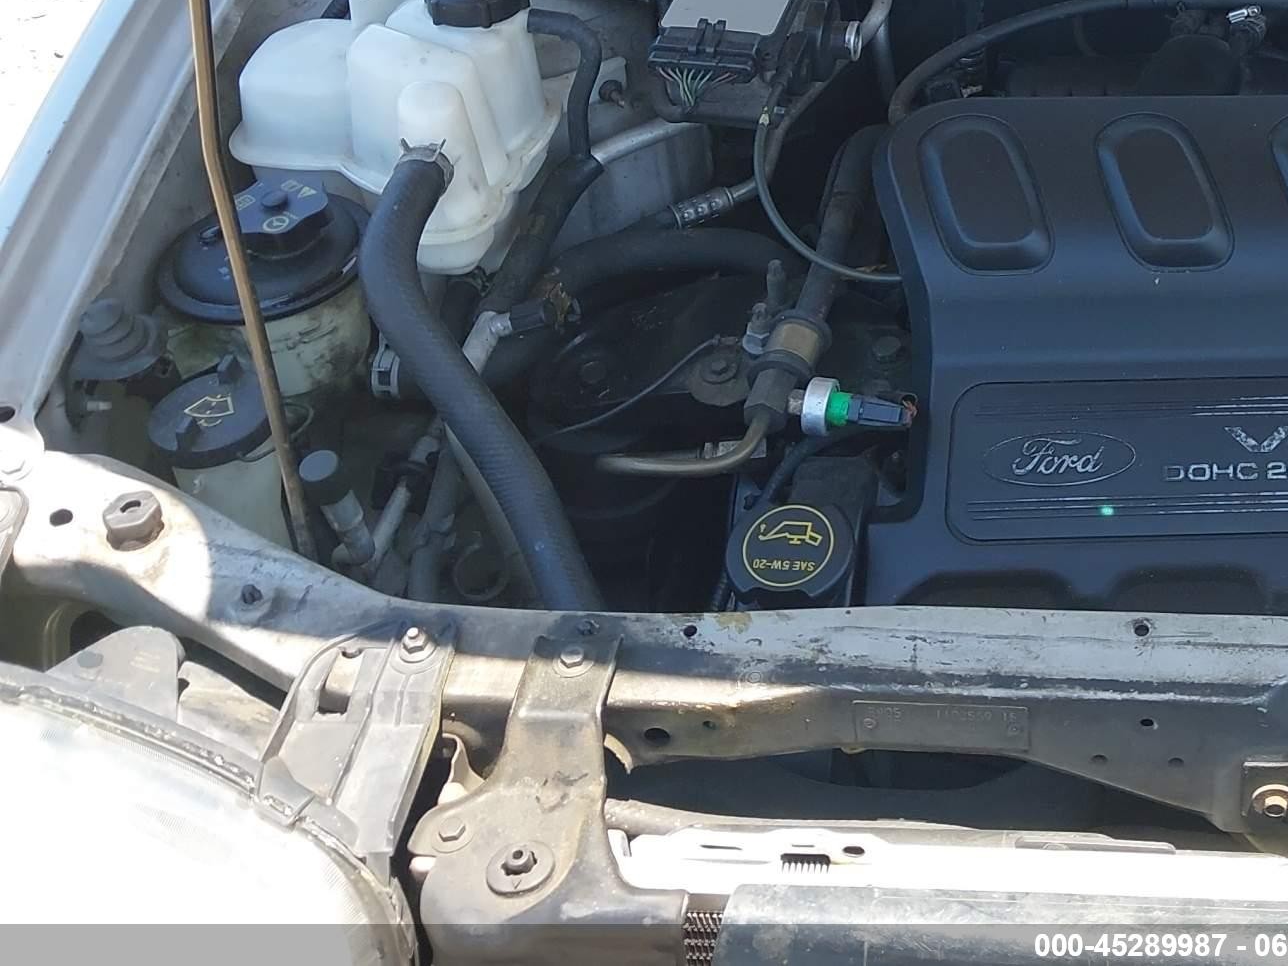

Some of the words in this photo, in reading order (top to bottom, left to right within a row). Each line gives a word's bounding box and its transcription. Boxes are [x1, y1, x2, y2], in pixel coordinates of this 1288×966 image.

[1012, 437, 1105, 475] Ford
[1164, 462, 1258, 481] DOHC
[752, 558, 791, 571] 5W-20
[791, 560, 816, 571] SAE
